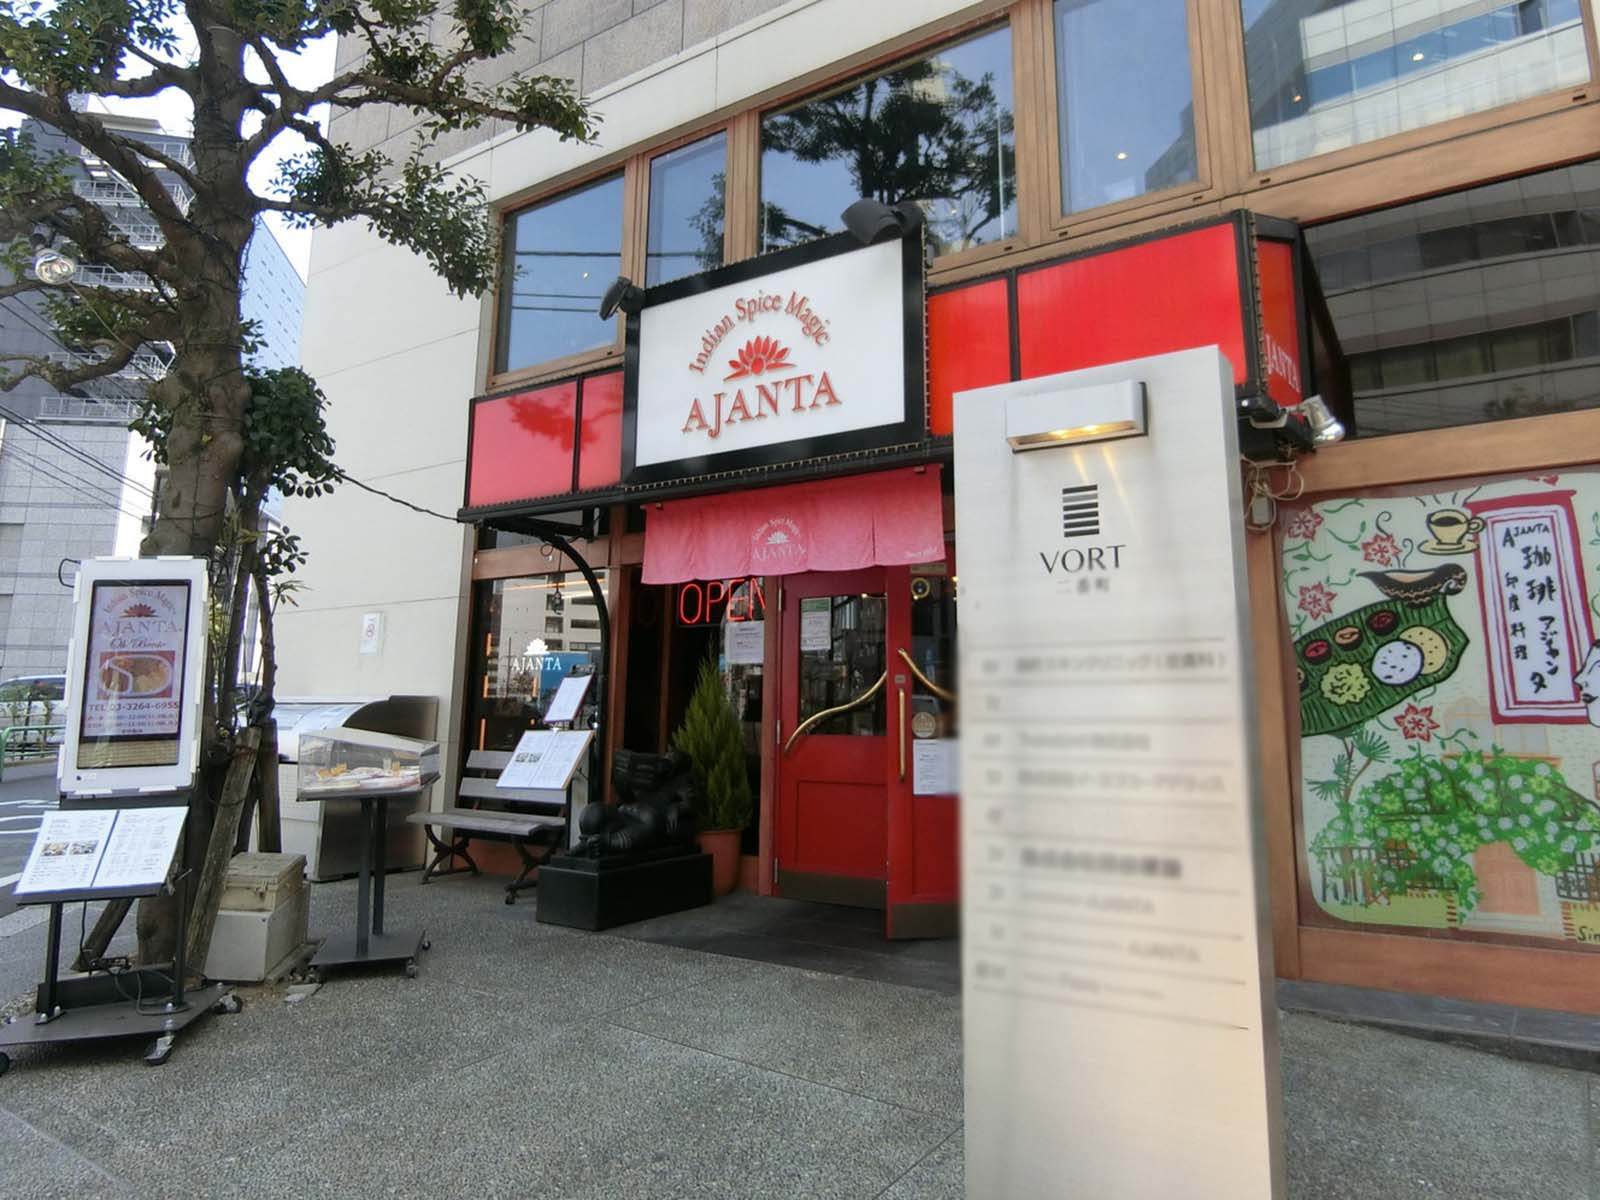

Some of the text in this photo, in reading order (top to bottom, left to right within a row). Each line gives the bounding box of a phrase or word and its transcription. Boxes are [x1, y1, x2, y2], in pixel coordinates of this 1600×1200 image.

[689, 289, 830, 374] Indian Spice Magic
[682, 371, 842, 439] AJANTA
[1502, 523, 1551, 548] AJANTA
[1040, 544, 1126, 574] VORT
[511, 656, 562, 674] AJANTA
